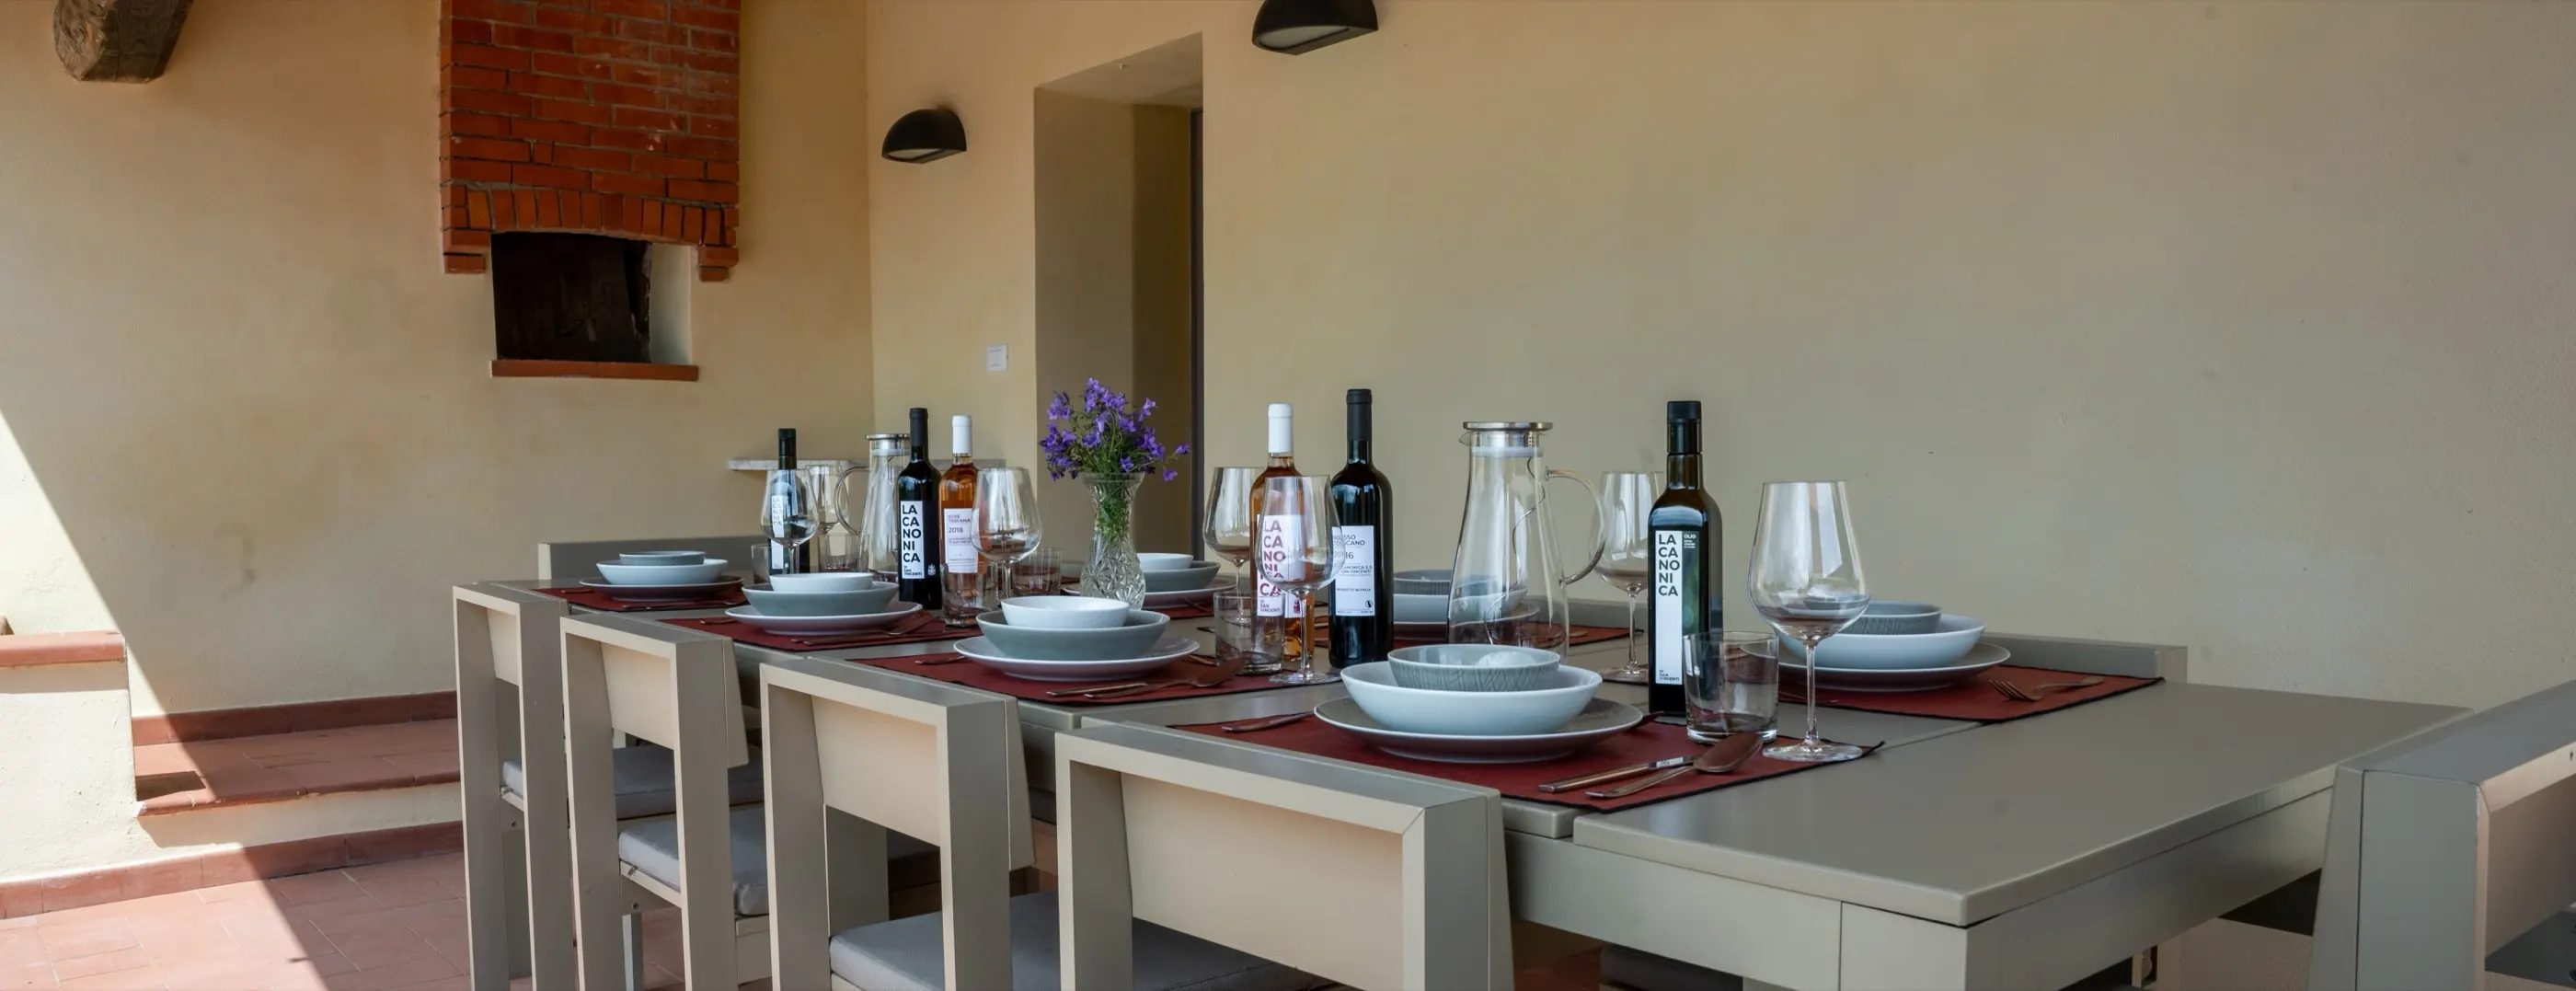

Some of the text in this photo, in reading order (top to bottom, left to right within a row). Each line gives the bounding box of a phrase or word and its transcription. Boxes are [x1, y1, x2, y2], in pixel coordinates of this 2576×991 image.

[902, 504, 917, 514] LA
[902, 517, 920, 526] CA
[1264, 520, 1282, 532] LA
[903, 528, 922, 538] NO
[1264, 536, 1283, 547] CA
[1659, 534, 1676, 545] LA
[903, 541, 914, 550] NI
[903, 553, 921, 562] CA
[1264, 551, 1285, 562] NO
[1658, 547, 1678, 558] CA
[1659, 559, 1680, 570] NO
[1659, 572, 1673, 583] NI
[1260, 582, 1282, 596] CA
[1658, 585, 1678, 596] CA
